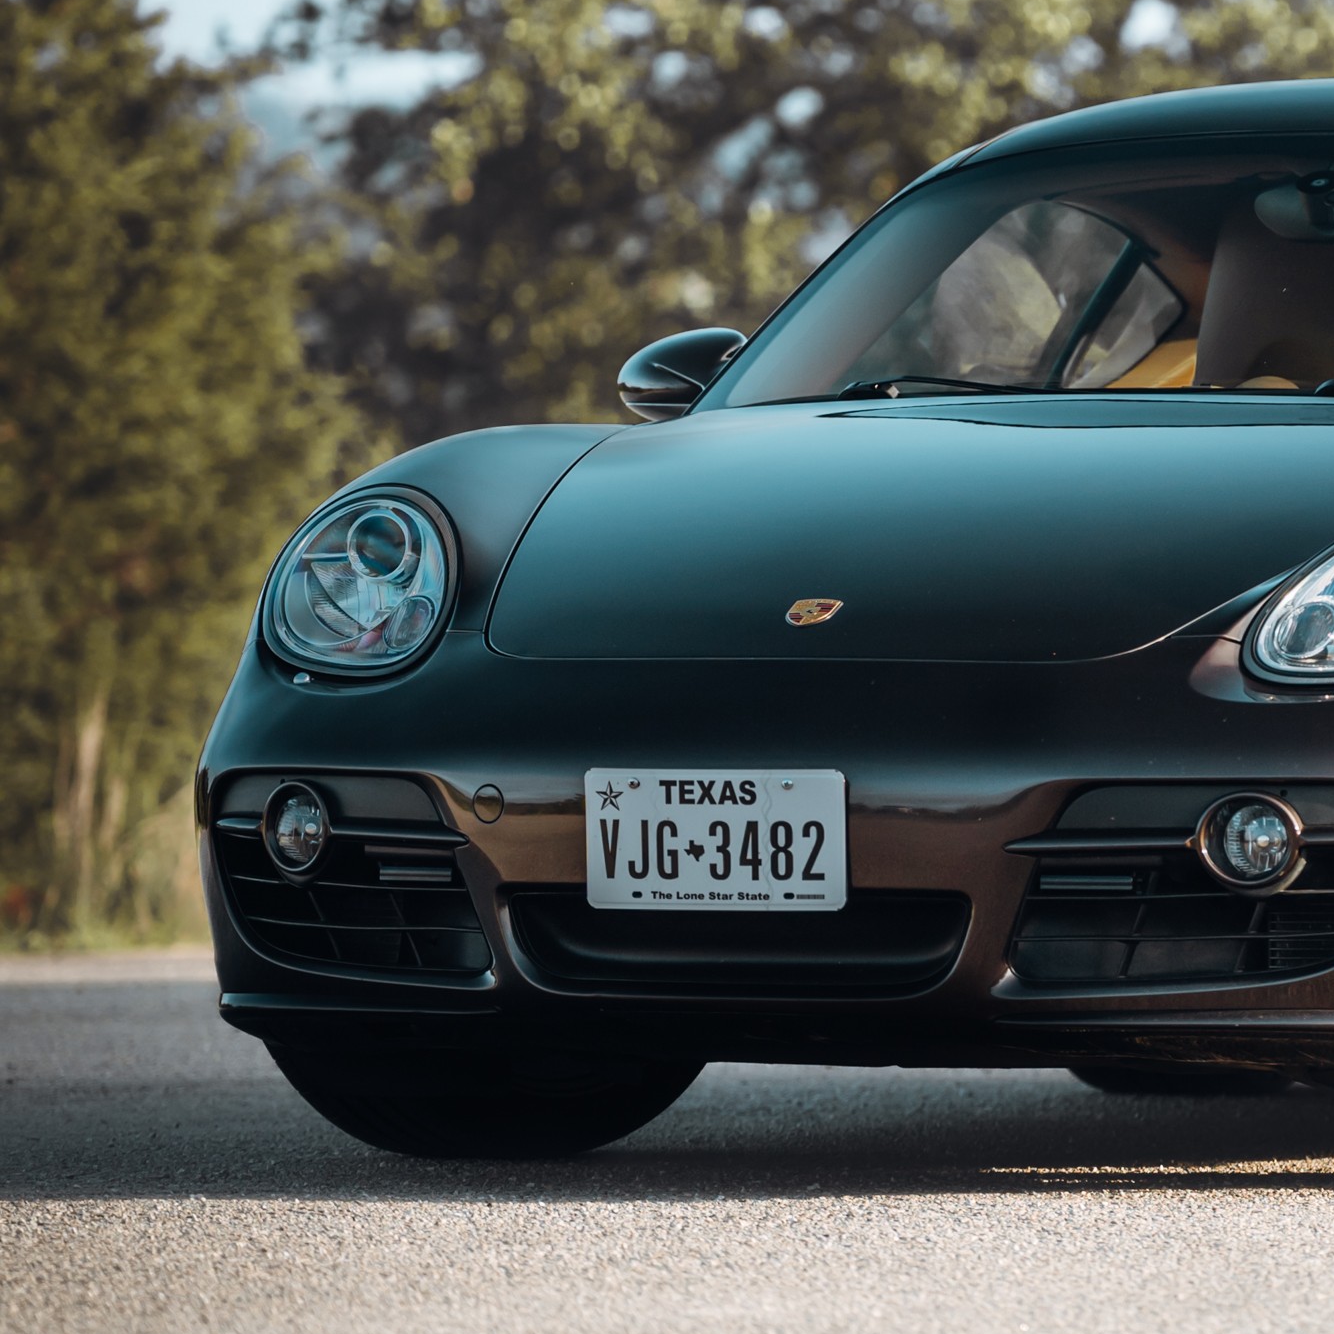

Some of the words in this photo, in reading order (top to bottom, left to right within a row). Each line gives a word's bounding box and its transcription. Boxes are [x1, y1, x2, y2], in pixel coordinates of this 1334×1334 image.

[659, 780, 757, 805] TEXAS
[651, 891, 673, 900] The
[676, 892, 705, 900] Lone
[708, 892, 734, 901] Star
[737, 892, 770, 901] State
